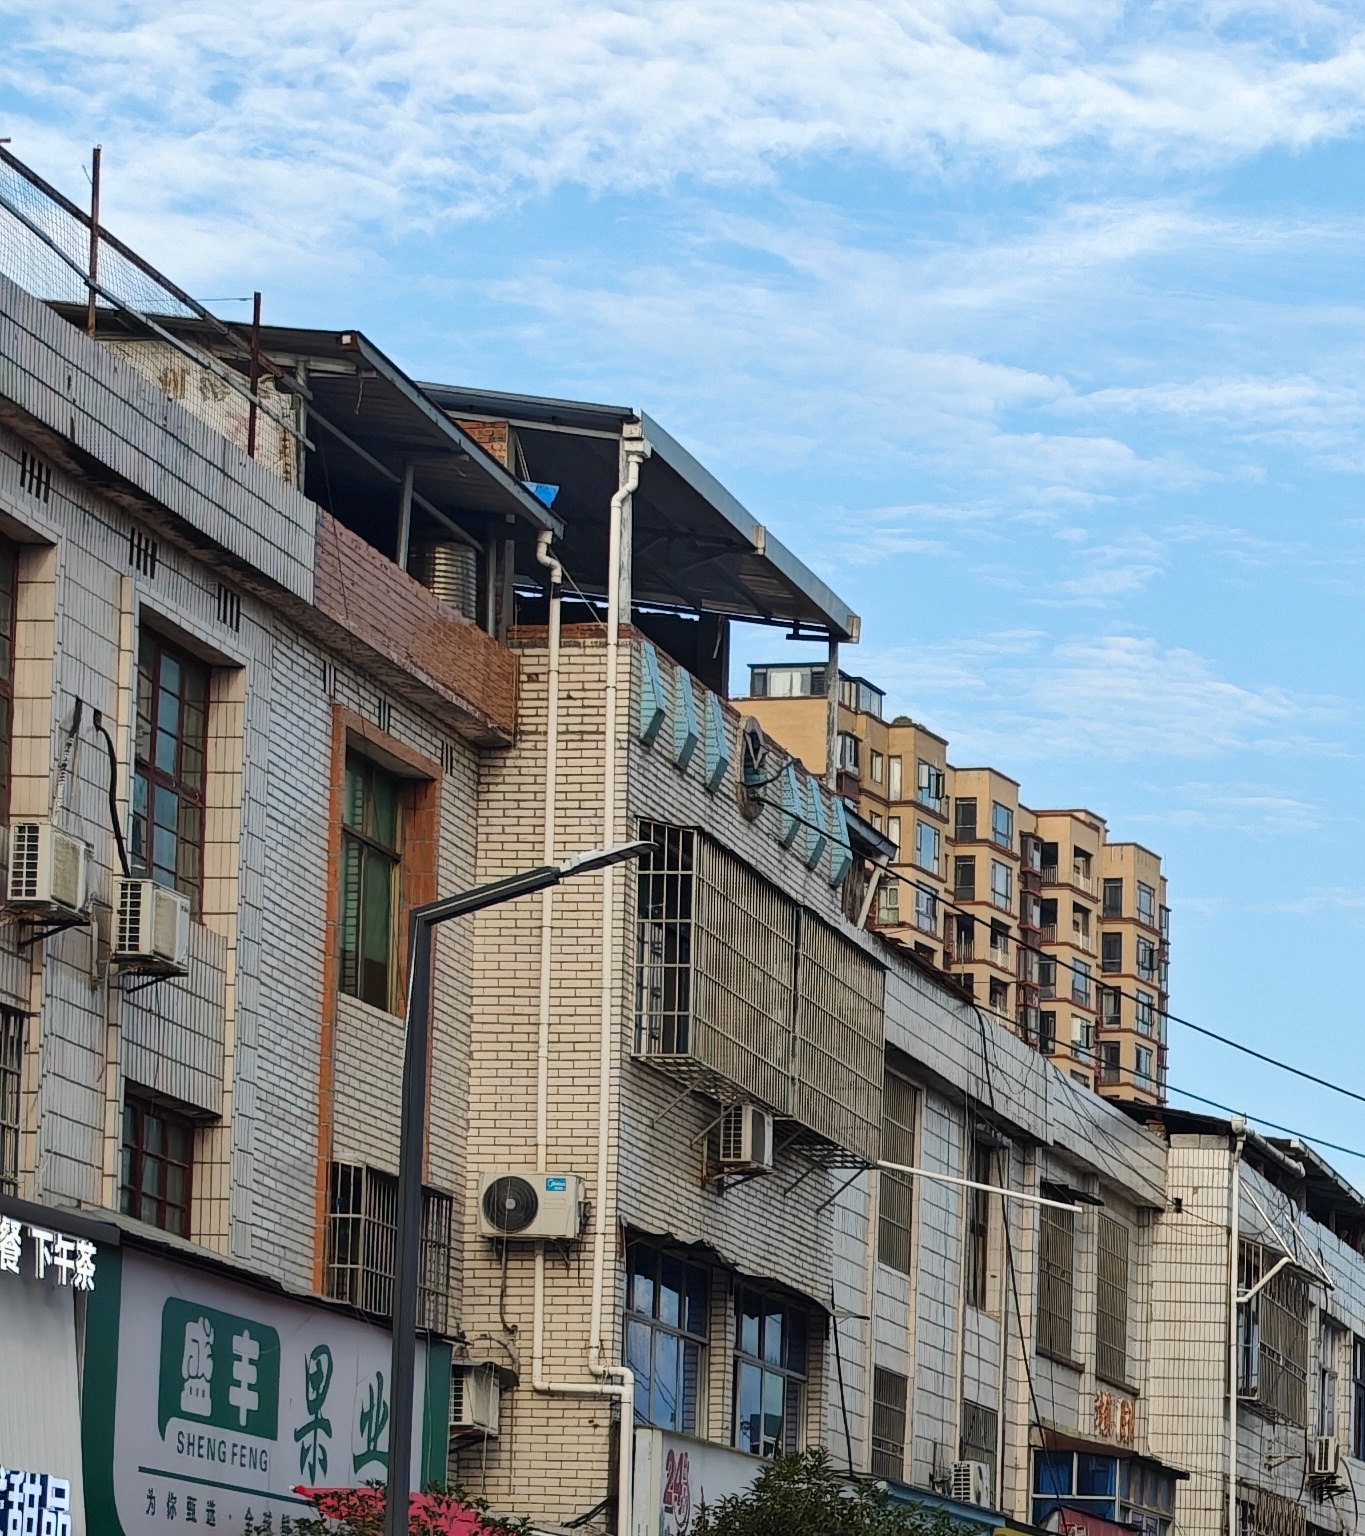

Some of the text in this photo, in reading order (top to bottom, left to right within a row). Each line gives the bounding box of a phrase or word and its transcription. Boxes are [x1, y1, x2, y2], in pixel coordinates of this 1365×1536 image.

[180, 1316, 261, 1427] 盛丰
[176, 1430, 269, 1472] SHENG FENG
